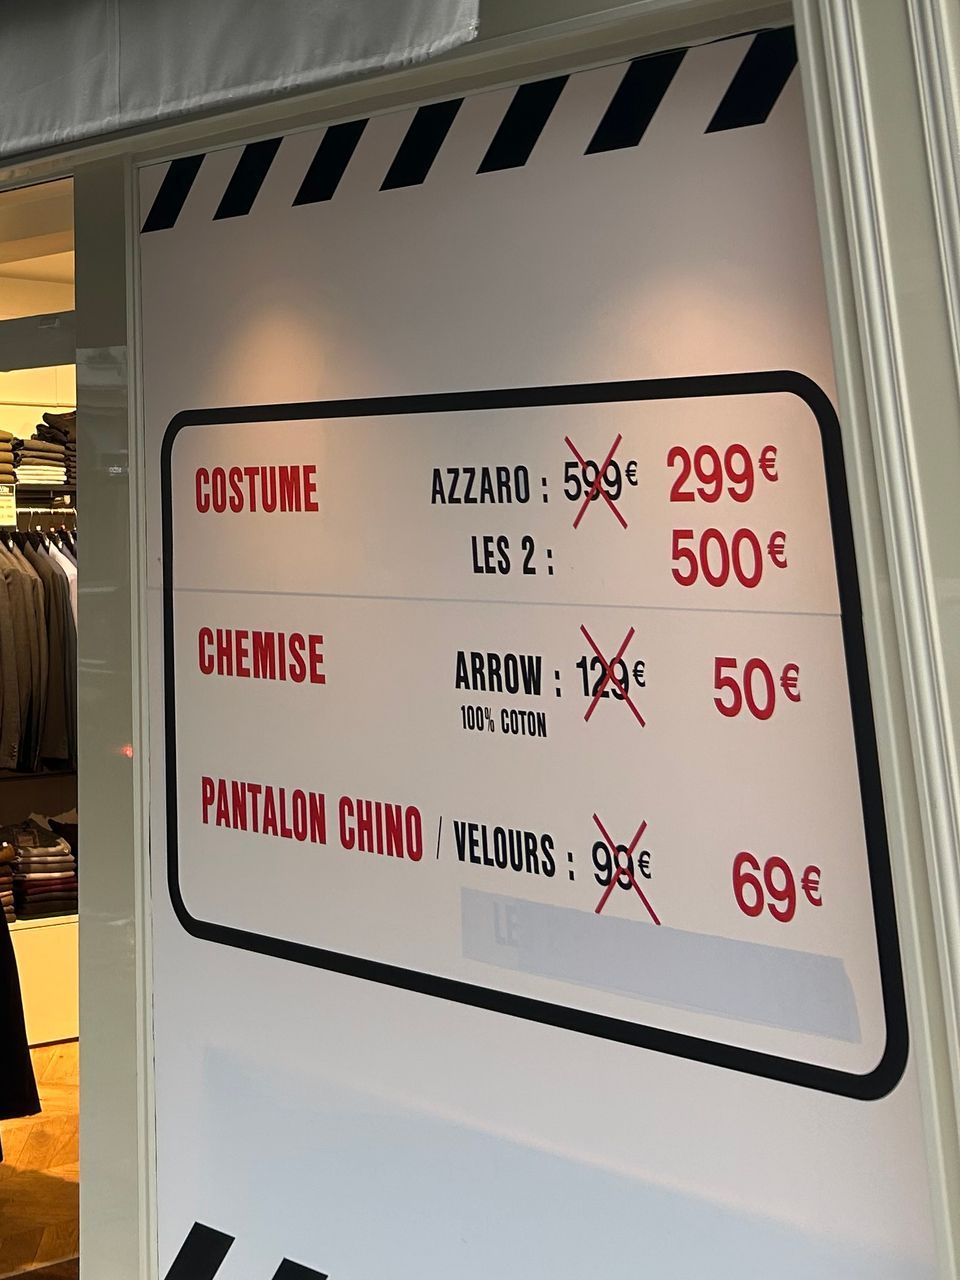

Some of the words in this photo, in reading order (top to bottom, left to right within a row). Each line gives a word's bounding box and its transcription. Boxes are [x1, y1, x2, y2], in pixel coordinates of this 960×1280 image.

[194, 463, 320, 514] COSTUME
[431, 465, 530, 505] AZZARO
[563, 455, 639, 502] 599€
[664, 442, 782, 506] 299€
[471, 535, 511, 575] LES
[521, 535, 537, 575] 2
[671, 527, 789, 590] 500€
[198, 627, 327, 685] CHEMISE
[455, 650, 542, 696] ARROW
[575, 655, 647, 703] 129€
[713, 656, 801, 721] 50€
[460, 705, 495, 733] 100%
[500, 708, 547, 738] COTON
[201, 776, 327, 845] PANTALON
[338, 795, 424, 862] CHINO
[453, 820, 556, 878] VELOURS
[732, 851, 823, 923] 69€
